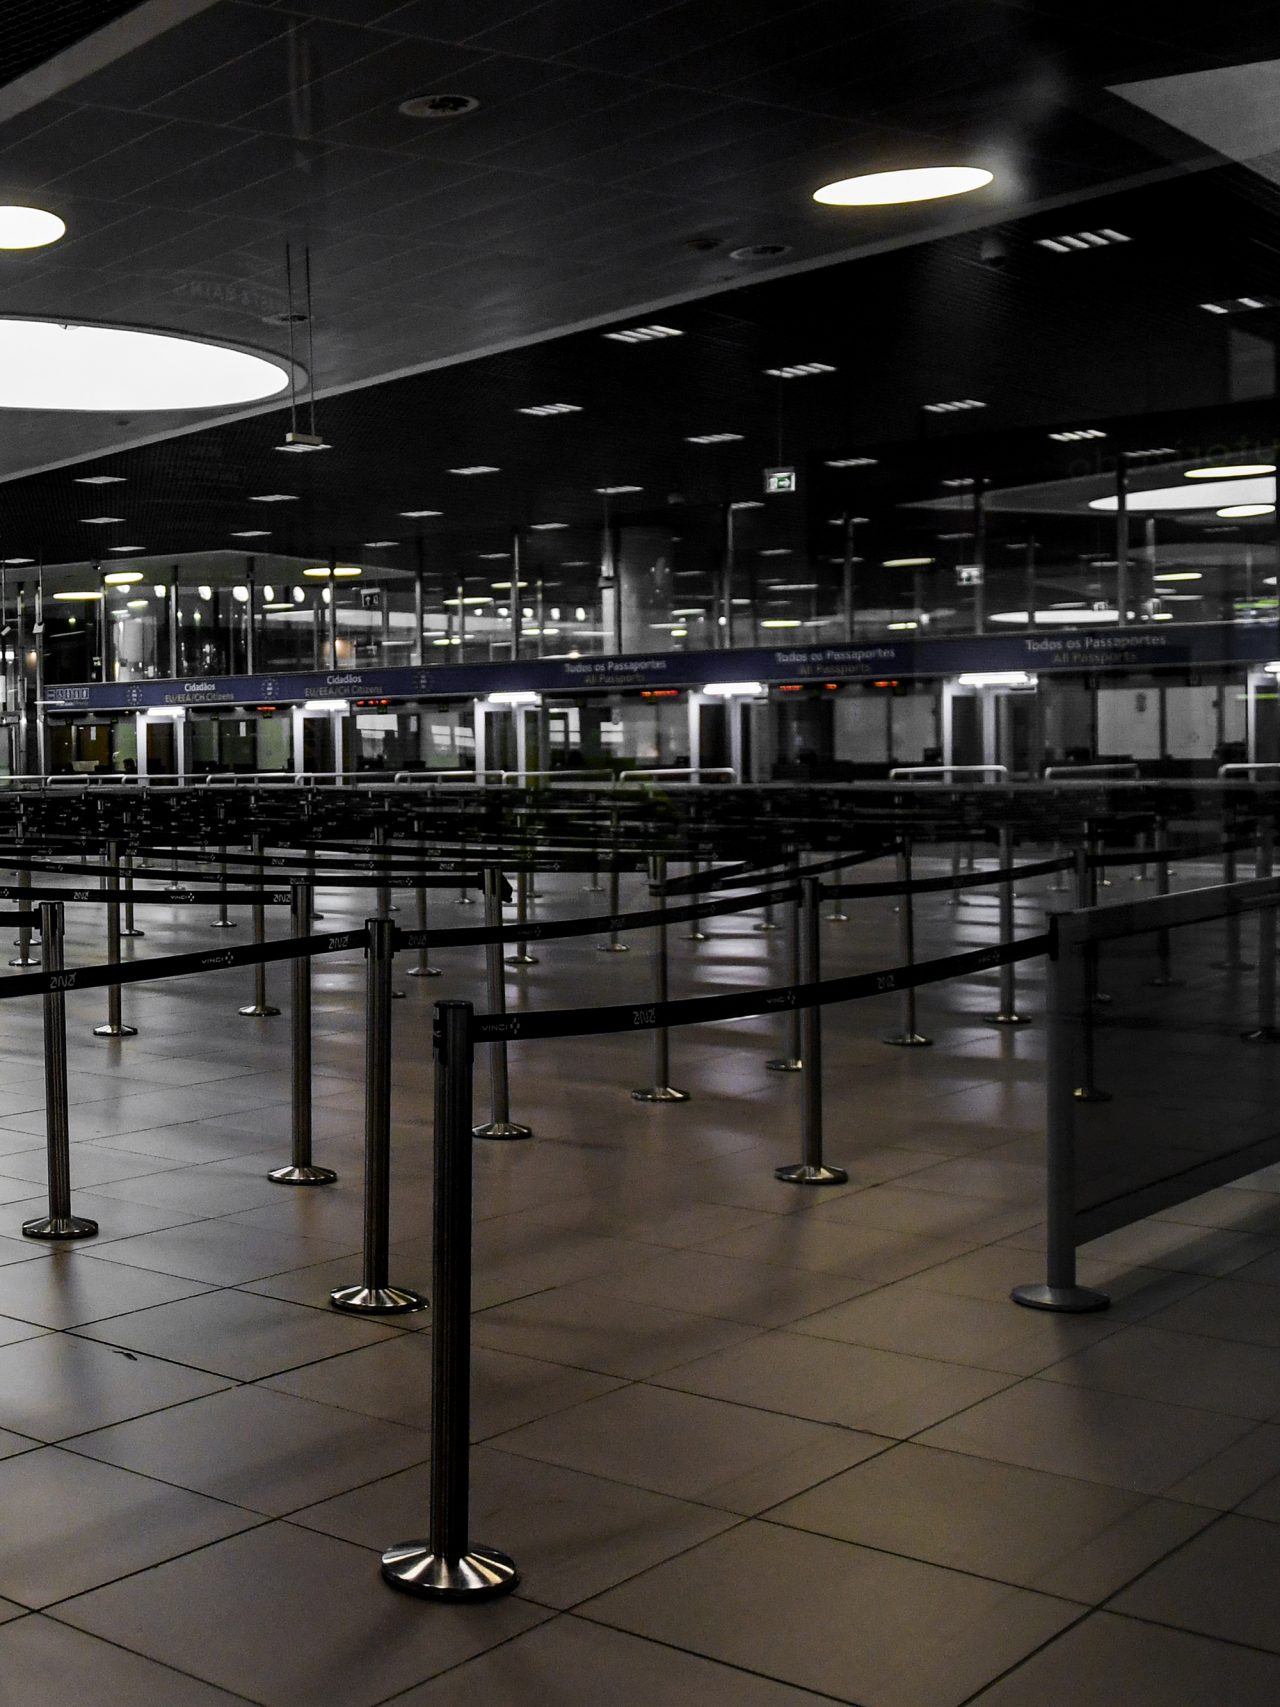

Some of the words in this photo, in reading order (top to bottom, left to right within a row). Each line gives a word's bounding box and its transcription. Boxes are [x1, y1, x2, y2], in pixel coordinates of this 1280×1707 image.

[1025, 639, 1063, 651] Todos
[1067, 640, 1082, 649] os
[1085, 634, 1167, 651] Passaportes
[776, 651, 807, 663] Todos
[811, 653, 823, 662] os
[826, 648, 896, 662] Passaportes
[564, 662, 593, 673] Todos
[595, 663, 606, 673] os
[607, 660, 667, 673] Passaportes
[326, 674, 362, 685] Cidadãos
[184, 683, 216, 692] Cidadãos
